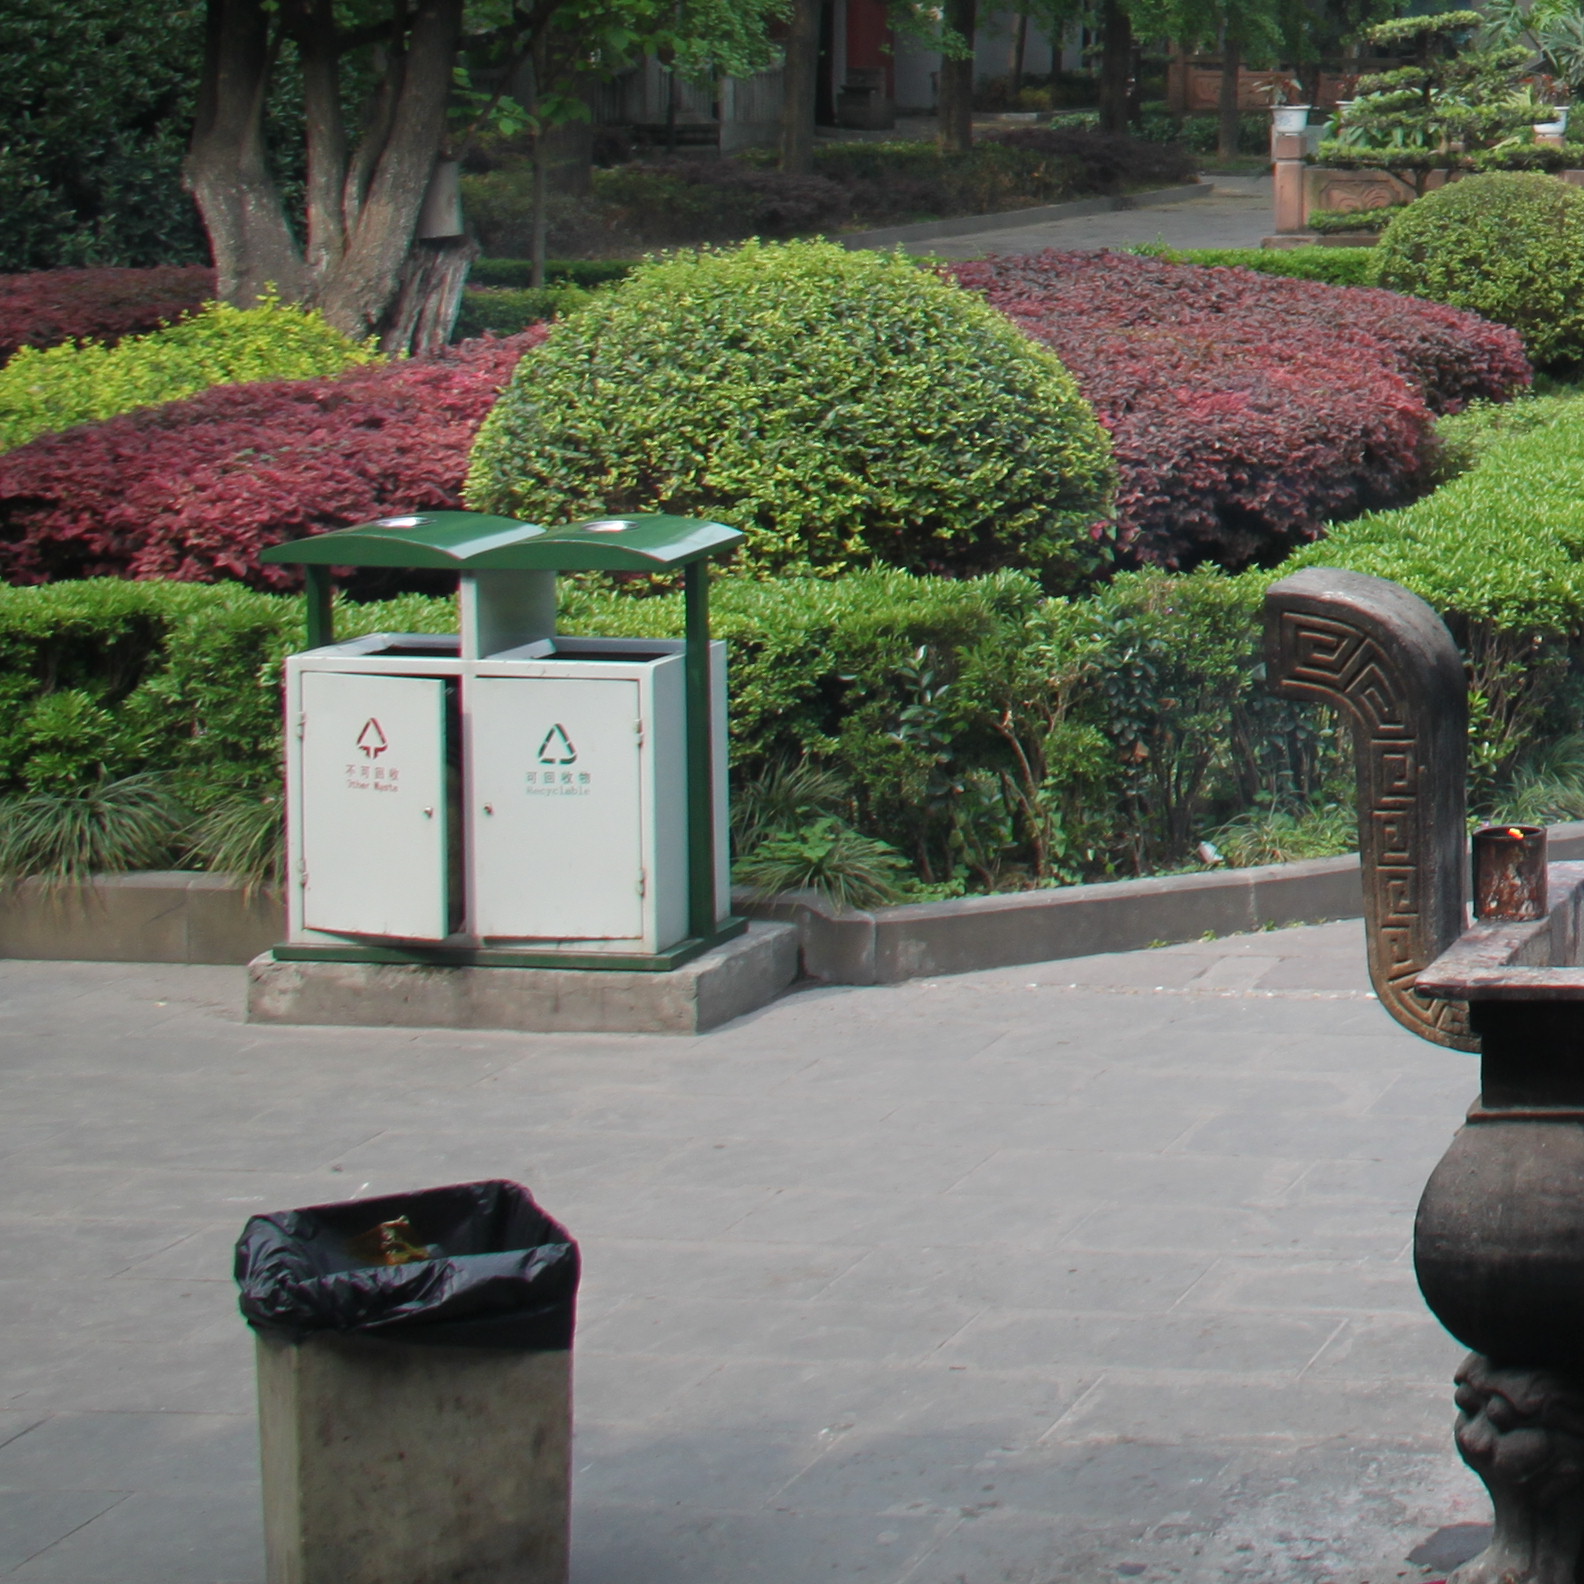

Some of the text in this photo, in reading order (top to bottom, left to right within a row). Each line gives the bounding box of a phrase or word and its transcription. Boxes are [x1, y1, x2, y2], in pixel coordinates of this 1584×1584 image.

[526, 771, 591, 784] 可回收物
[526, 785, 591, 796] Recyclable
